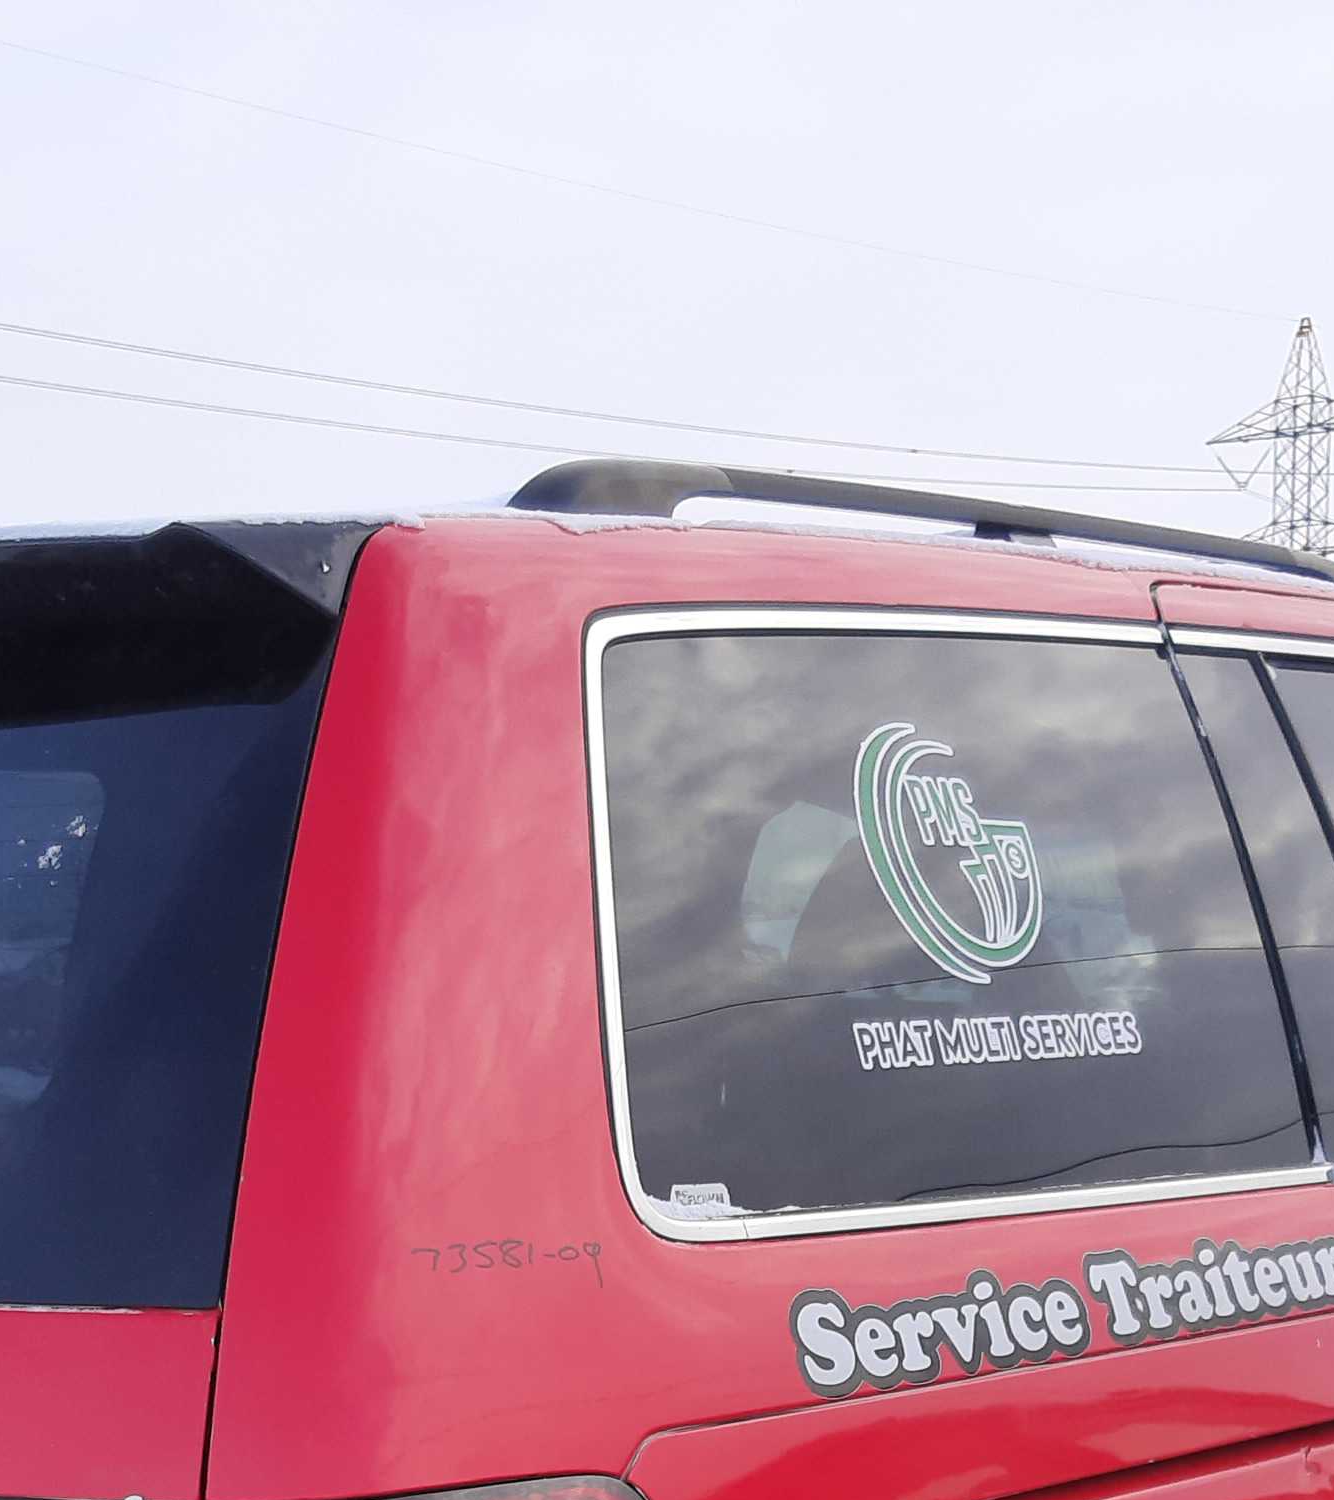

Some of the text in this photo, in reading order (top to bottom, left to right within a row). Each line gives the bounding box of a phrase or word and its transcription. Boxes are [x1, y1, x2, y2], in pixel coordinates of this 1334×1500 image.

[904, 774, 990, 847] PMS
[853, 1011, 1142, 1070] PHAT MULTI SERVICES
[410, 1239, 603, 1289] 73581-09
[794, 1275, 1086, 1391] Service
